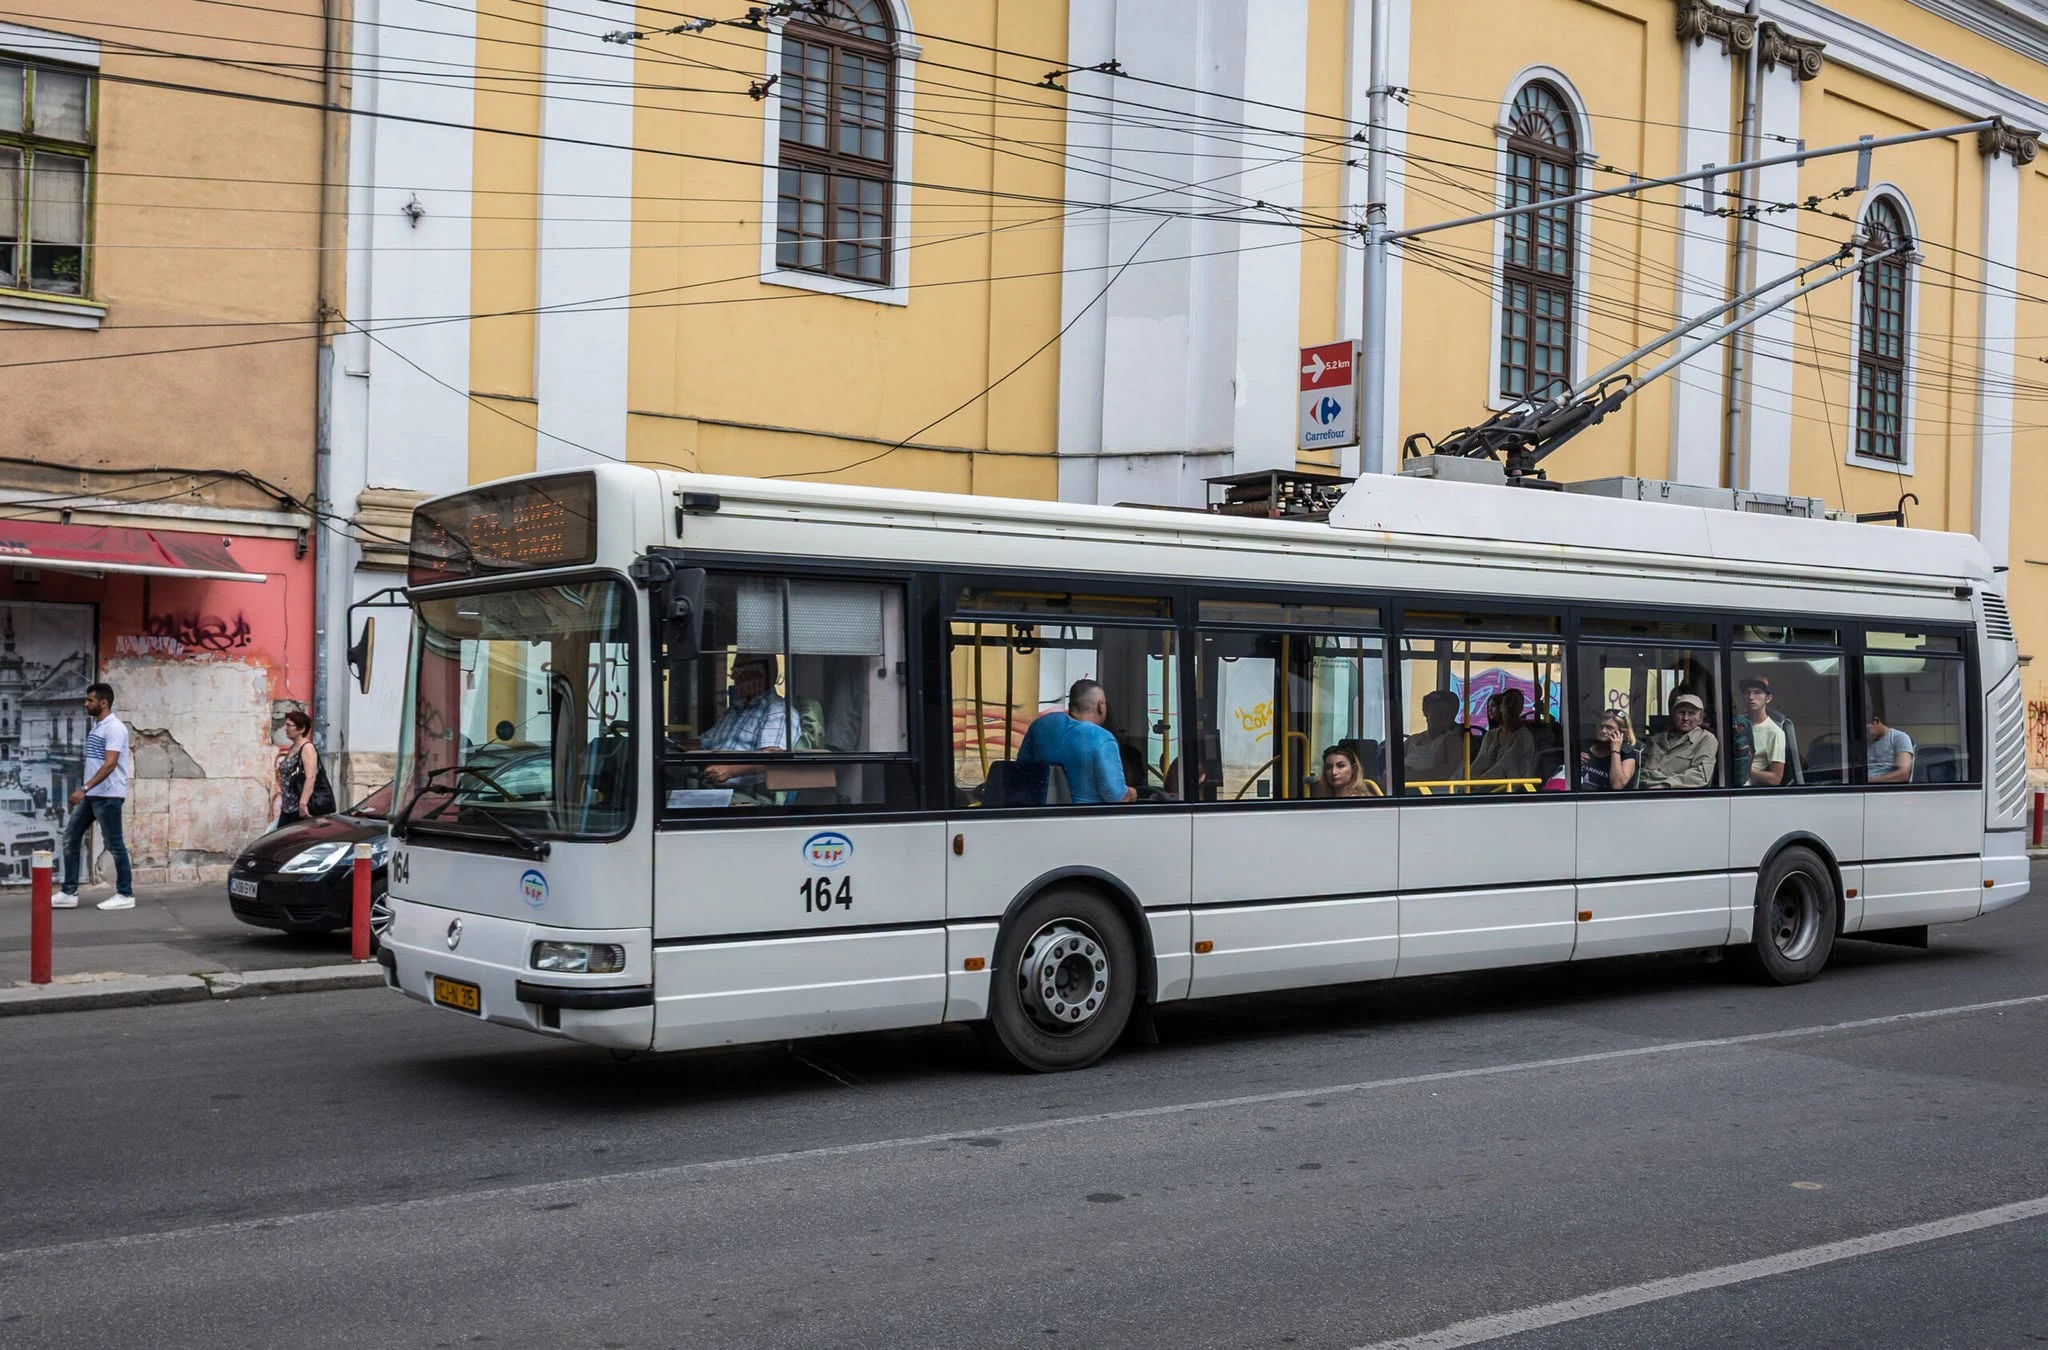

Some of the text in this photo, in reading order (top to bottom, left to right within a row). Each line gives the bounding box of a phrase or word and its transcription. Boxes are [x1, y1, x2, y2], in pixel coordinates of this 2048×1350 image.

[1325, 359, 1350, 370] 5.2 km
[1305, 428, 1346, 441] Carrefour
[392, 850, 410, 885] 164
[800, 875, 853, 913] 164
